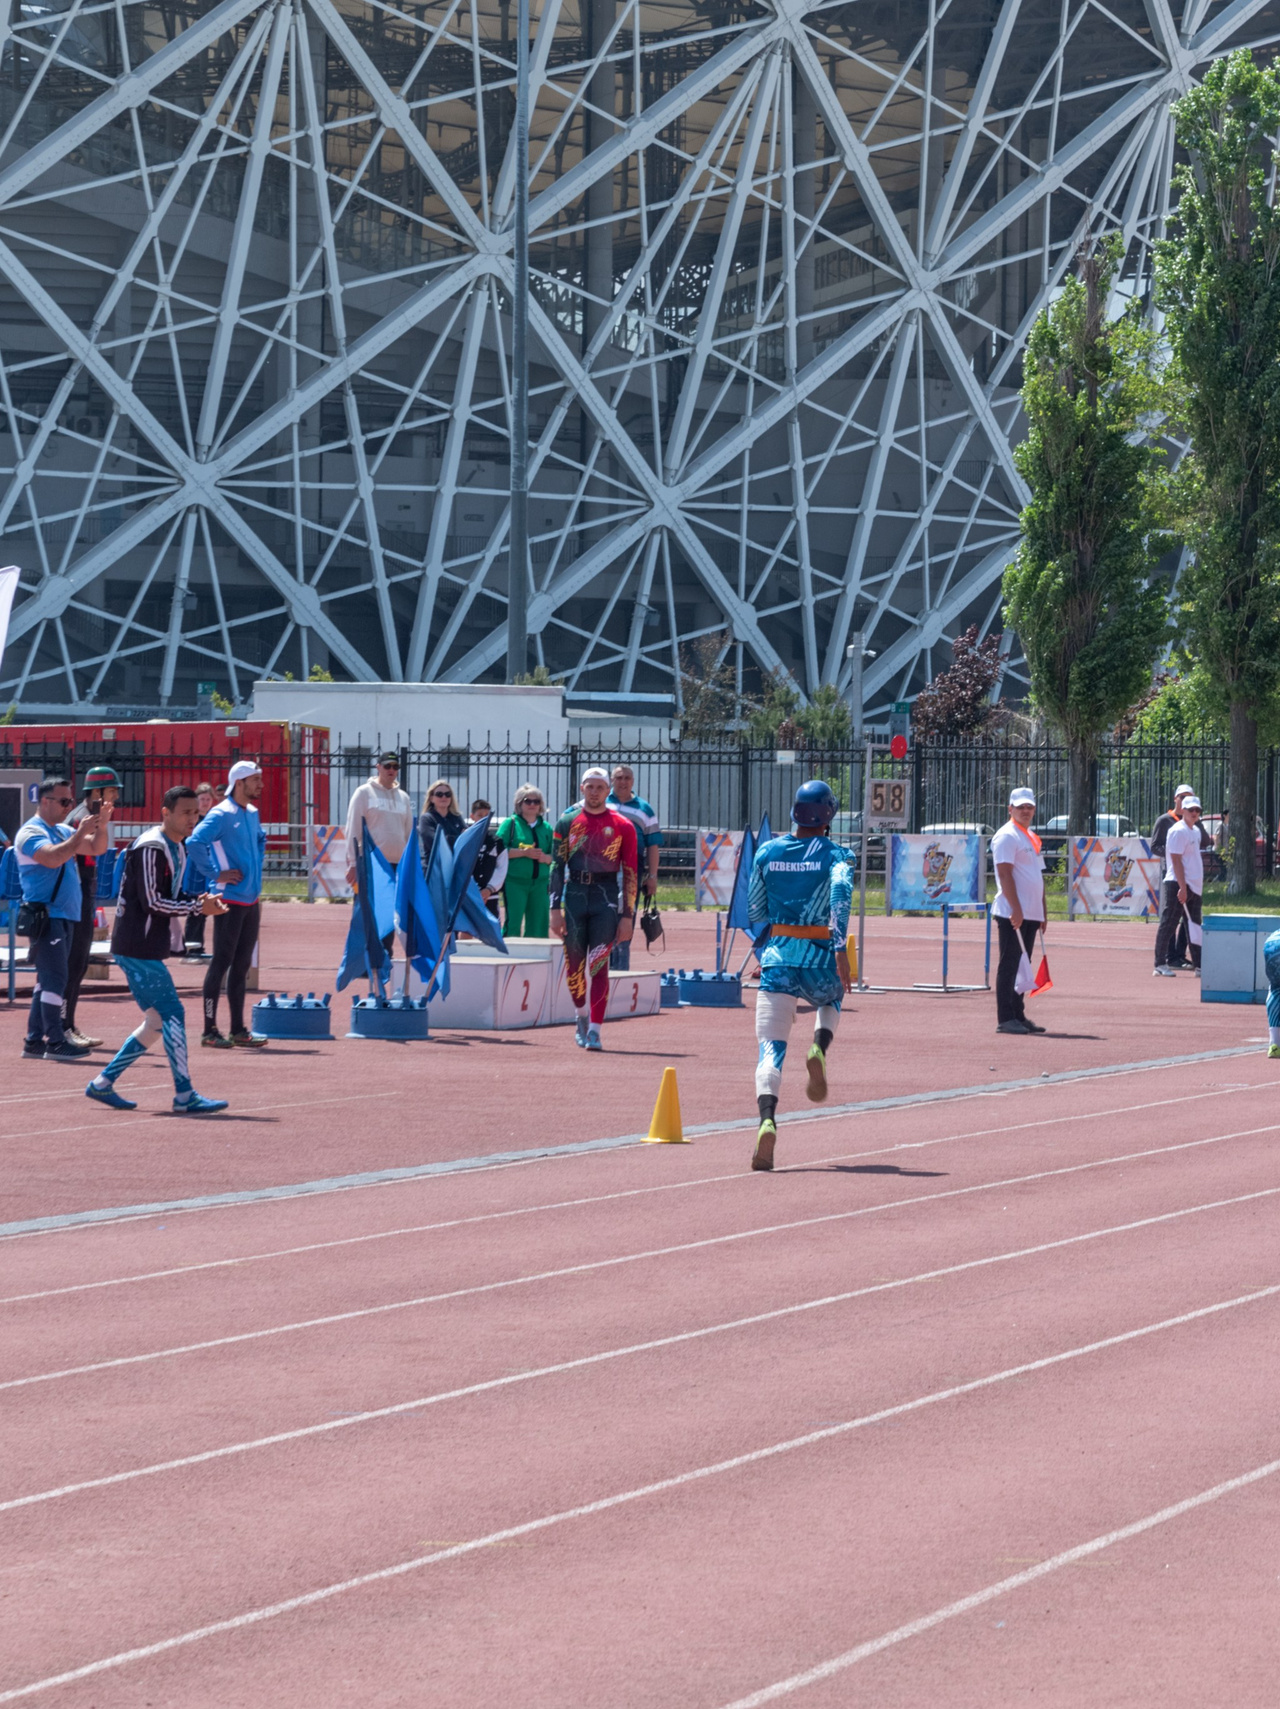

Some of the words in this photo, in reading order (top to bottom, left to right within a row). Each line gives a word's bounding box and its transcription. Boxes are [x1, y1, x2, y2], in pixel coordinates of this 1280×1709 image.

[30, 786, 38, 802] 1
[873, 783, 903, 812] 58
[769, 861, 822, 872] UZBEKISTAN
[521, 980, 530, 1011] 2
[630, 982, 639, 1012] 3
[206, 998, 214, 1018] ASICS
